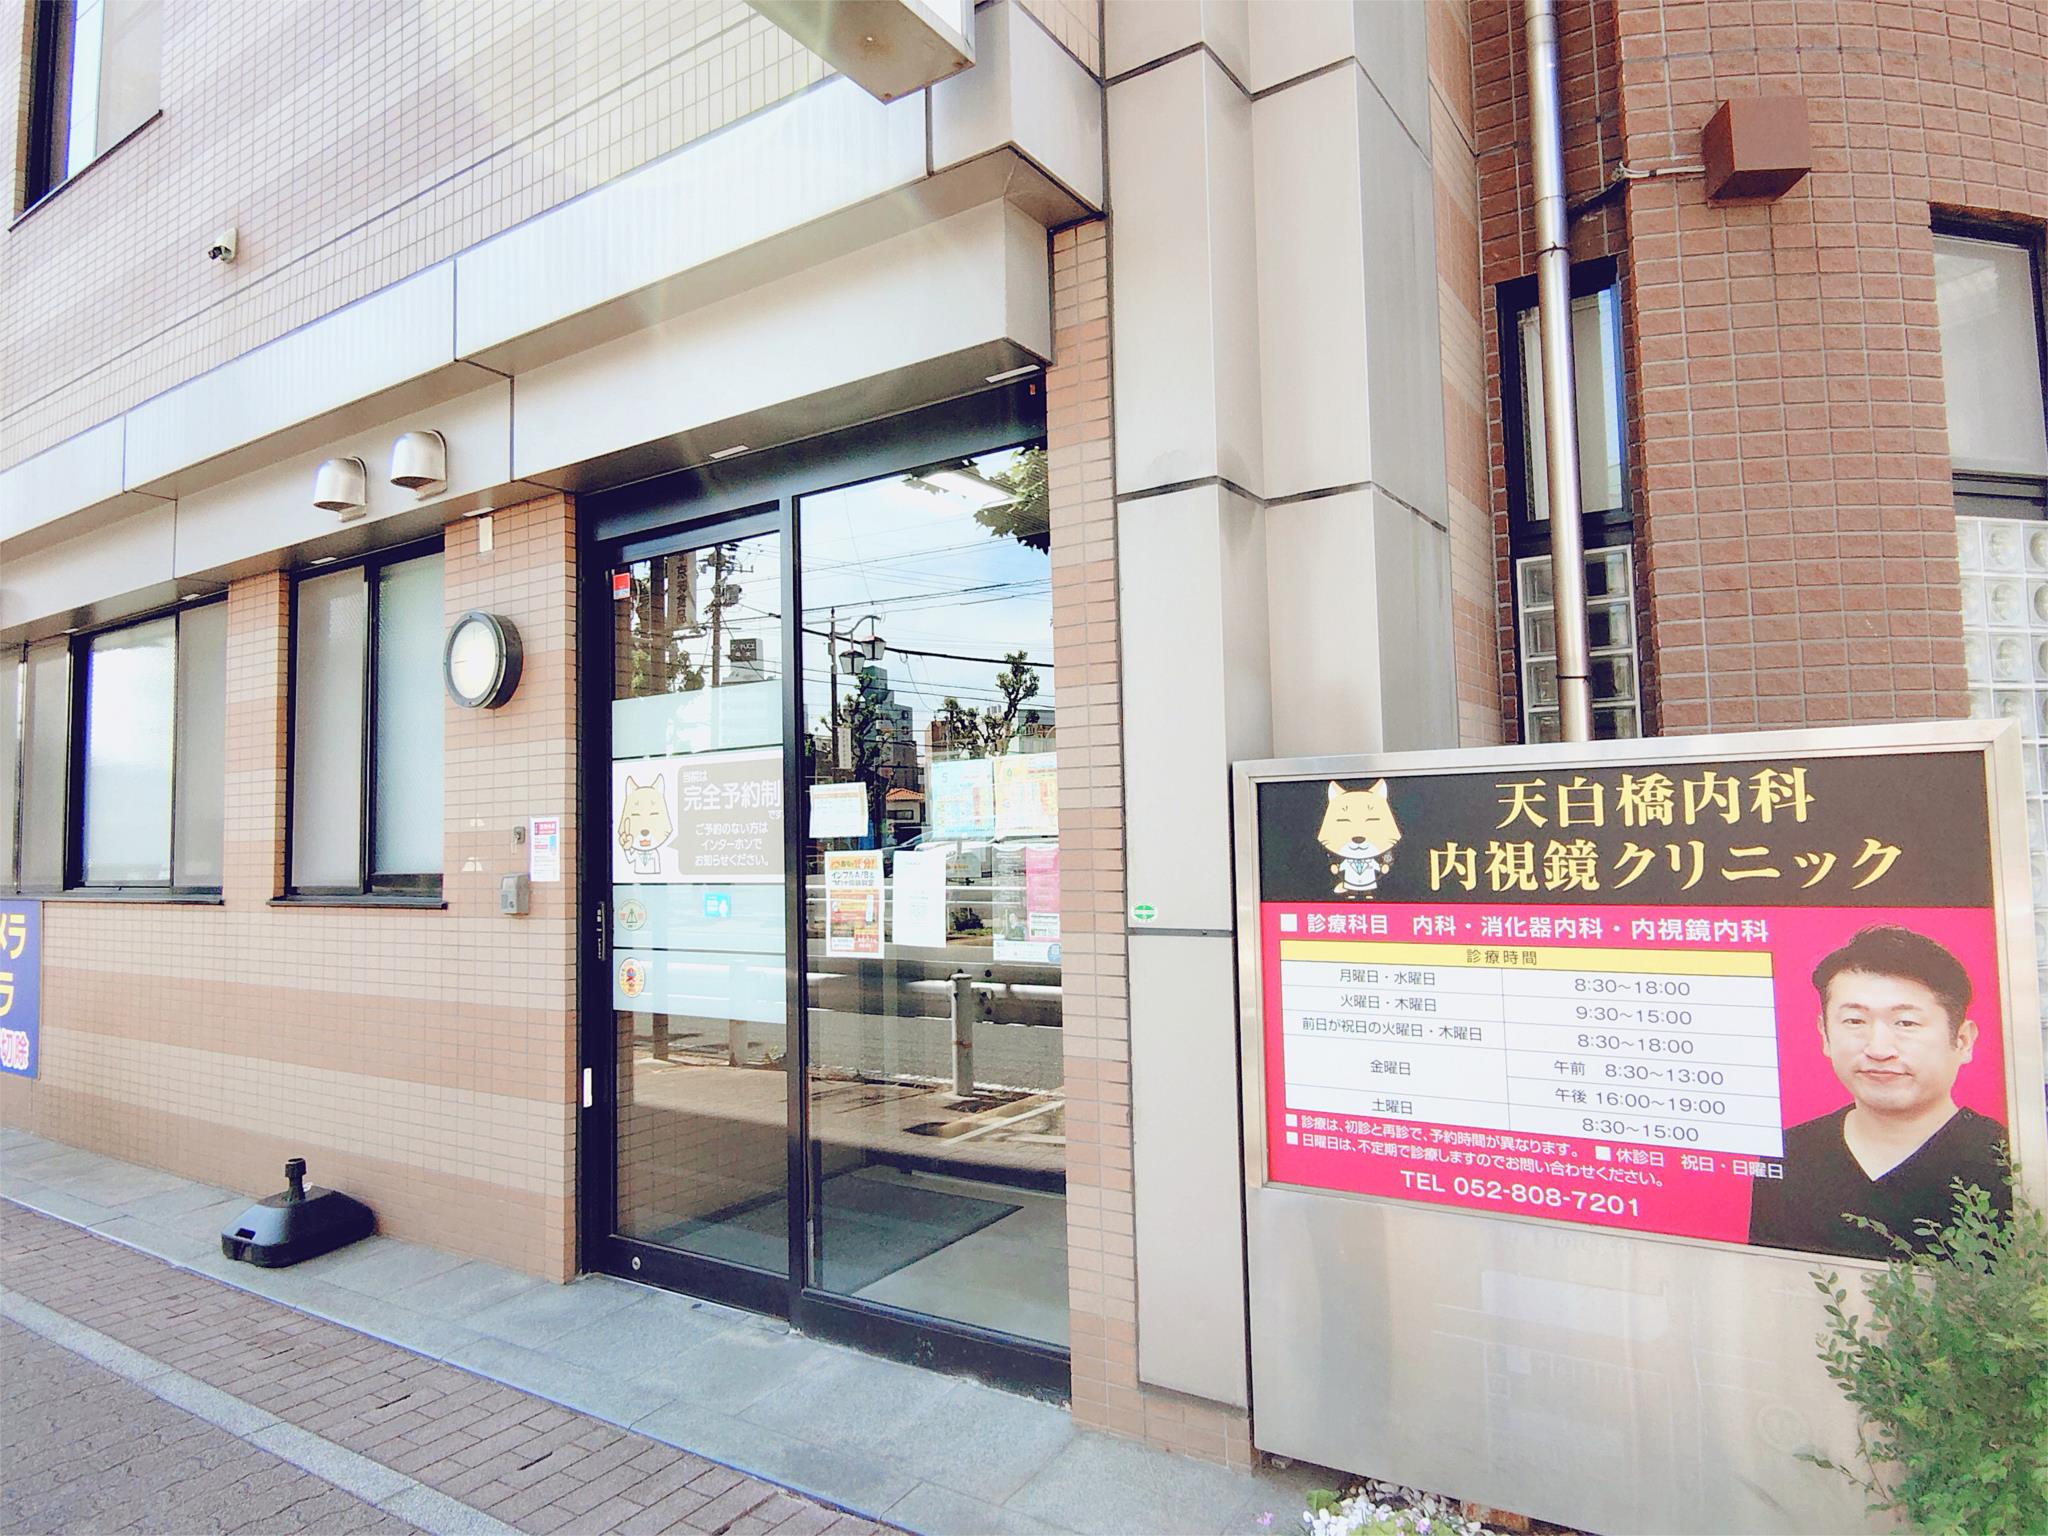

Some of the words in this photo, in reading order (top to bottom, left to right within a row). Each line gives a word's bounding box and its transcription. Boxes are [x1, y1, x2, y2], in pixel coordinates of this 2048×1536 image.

[683, 779, 781, 811] 完全予約制
[1494, 767, 1816, 829] 天白橋内科
[695, 821, 769, 836] ご予約のない方は
[702, 838, 762, 851] インターホンで
[695, 854, 769, 867] お知らせください。
[1429, 838, 1902, 893] 内視鏡クリニック
[1307, 912, 1389, 935] 診療科目
[1412, 914, 1769, 944] 内科・消化器内科・内視鏡内科
[1466, 948, 1538, 966] 診療時間
[1339, 967, 1436, 987] 月曜日・水曜日
[1340, 994, 1437, 1013] 火曜日・木曜日
[1302, 1016, 1483, 1042] 前日が祝日の火曜日・木曜日
[1370, 1059, 1412, 1077] 金曜日
[1553, 1060, 1586, 1077] 午前
[1555, 1087, 1587, 1105] 午後
[1371, 1098, 1413, 1116] 土曜日
[1301, 1114, 1579, 1158] 診療は、初診と再診で、予約時間が異なります。
[1302, 1133, 1664, 1189] 日曜日は、不定期で診療しますのでお問い合わせください。
[1615, 1147, 1665, 1168] 休診日
[1680, 1153, 1784, 1180] 祝日・日曜日
[1400, 1170, 1446, 1194] TEL
[1453, 1178, 1640, 1217] 052-808-7201
